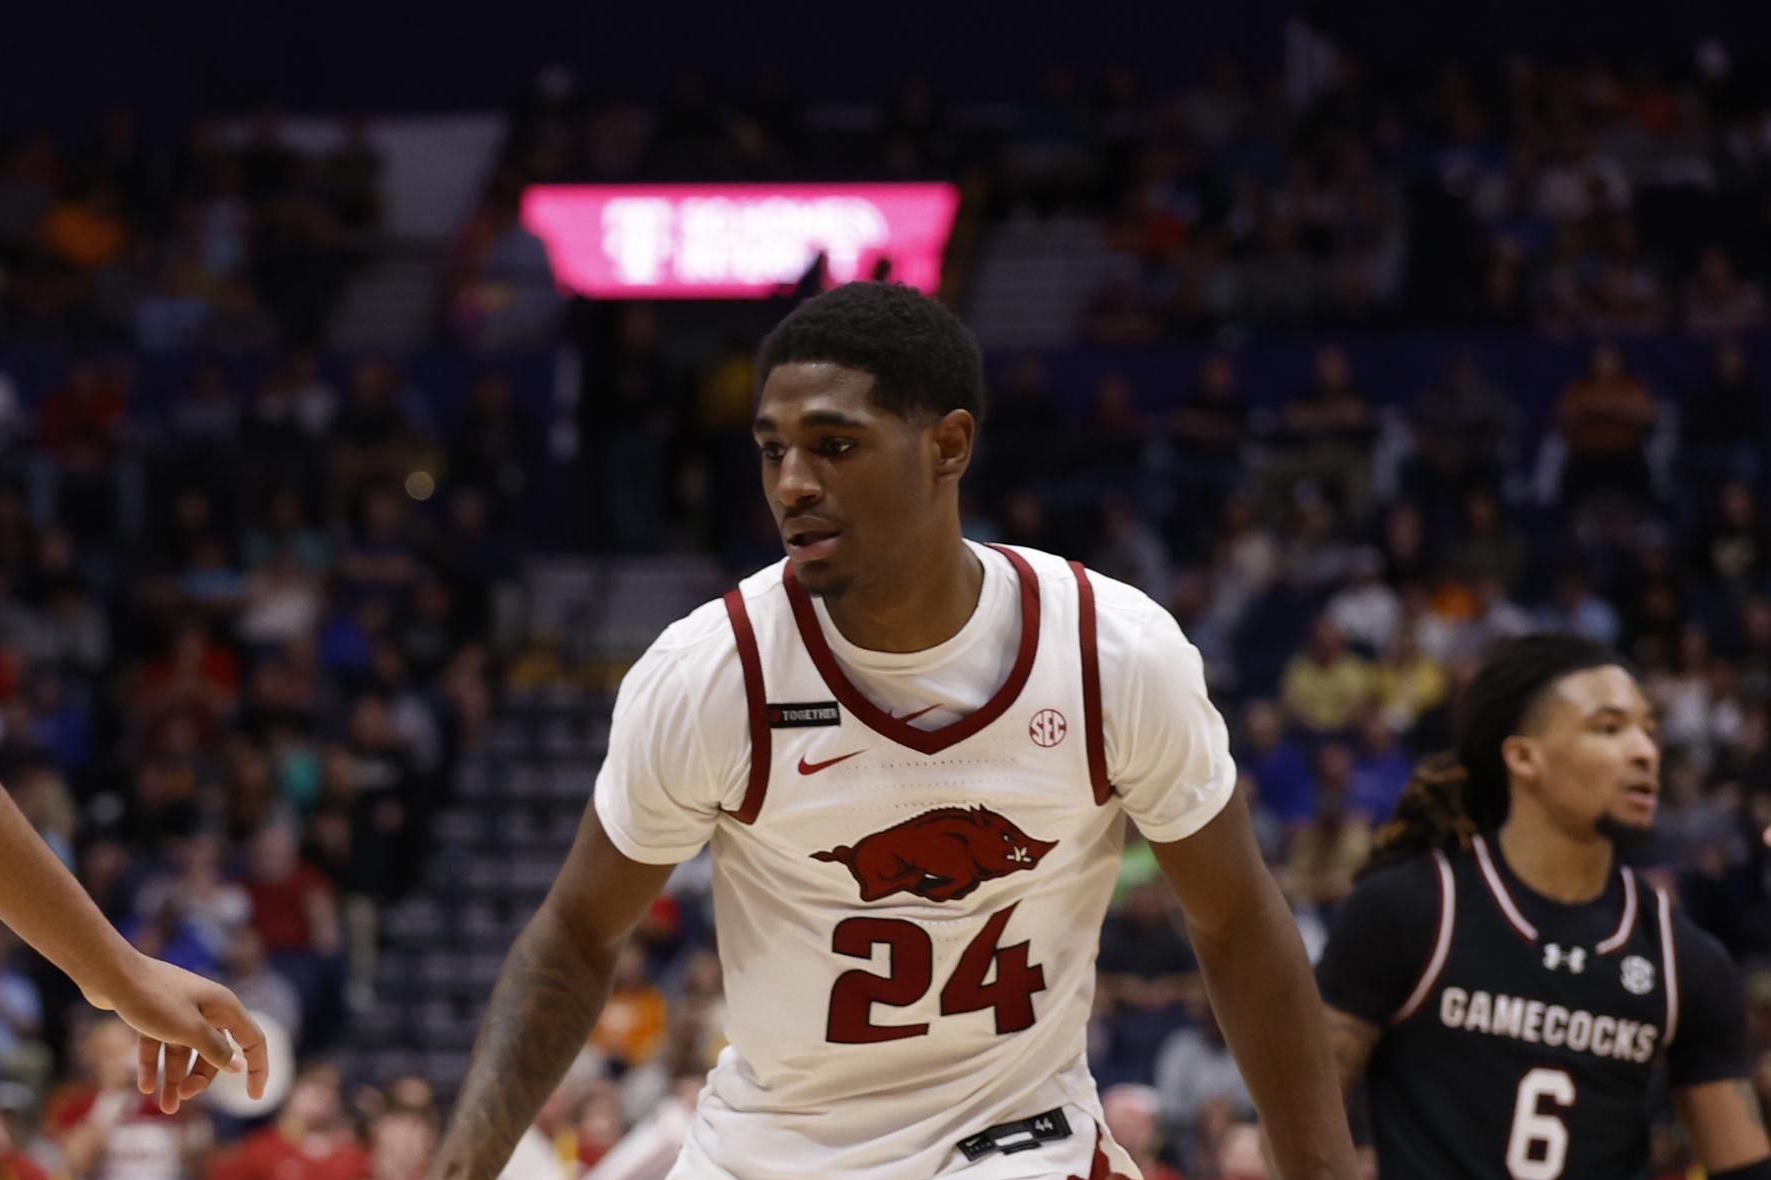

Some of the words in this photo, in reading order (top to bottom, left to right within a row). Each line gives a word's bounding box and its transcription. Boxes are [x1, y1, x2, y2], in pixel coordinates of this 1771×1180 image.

[782, 708, 838, 721] TOGETHER
[1029, 709, 1067, 748] SEC
[826, 898, 1047, 1044] 24
[1440, 986, 1659, 1063] GAMECOCKS
